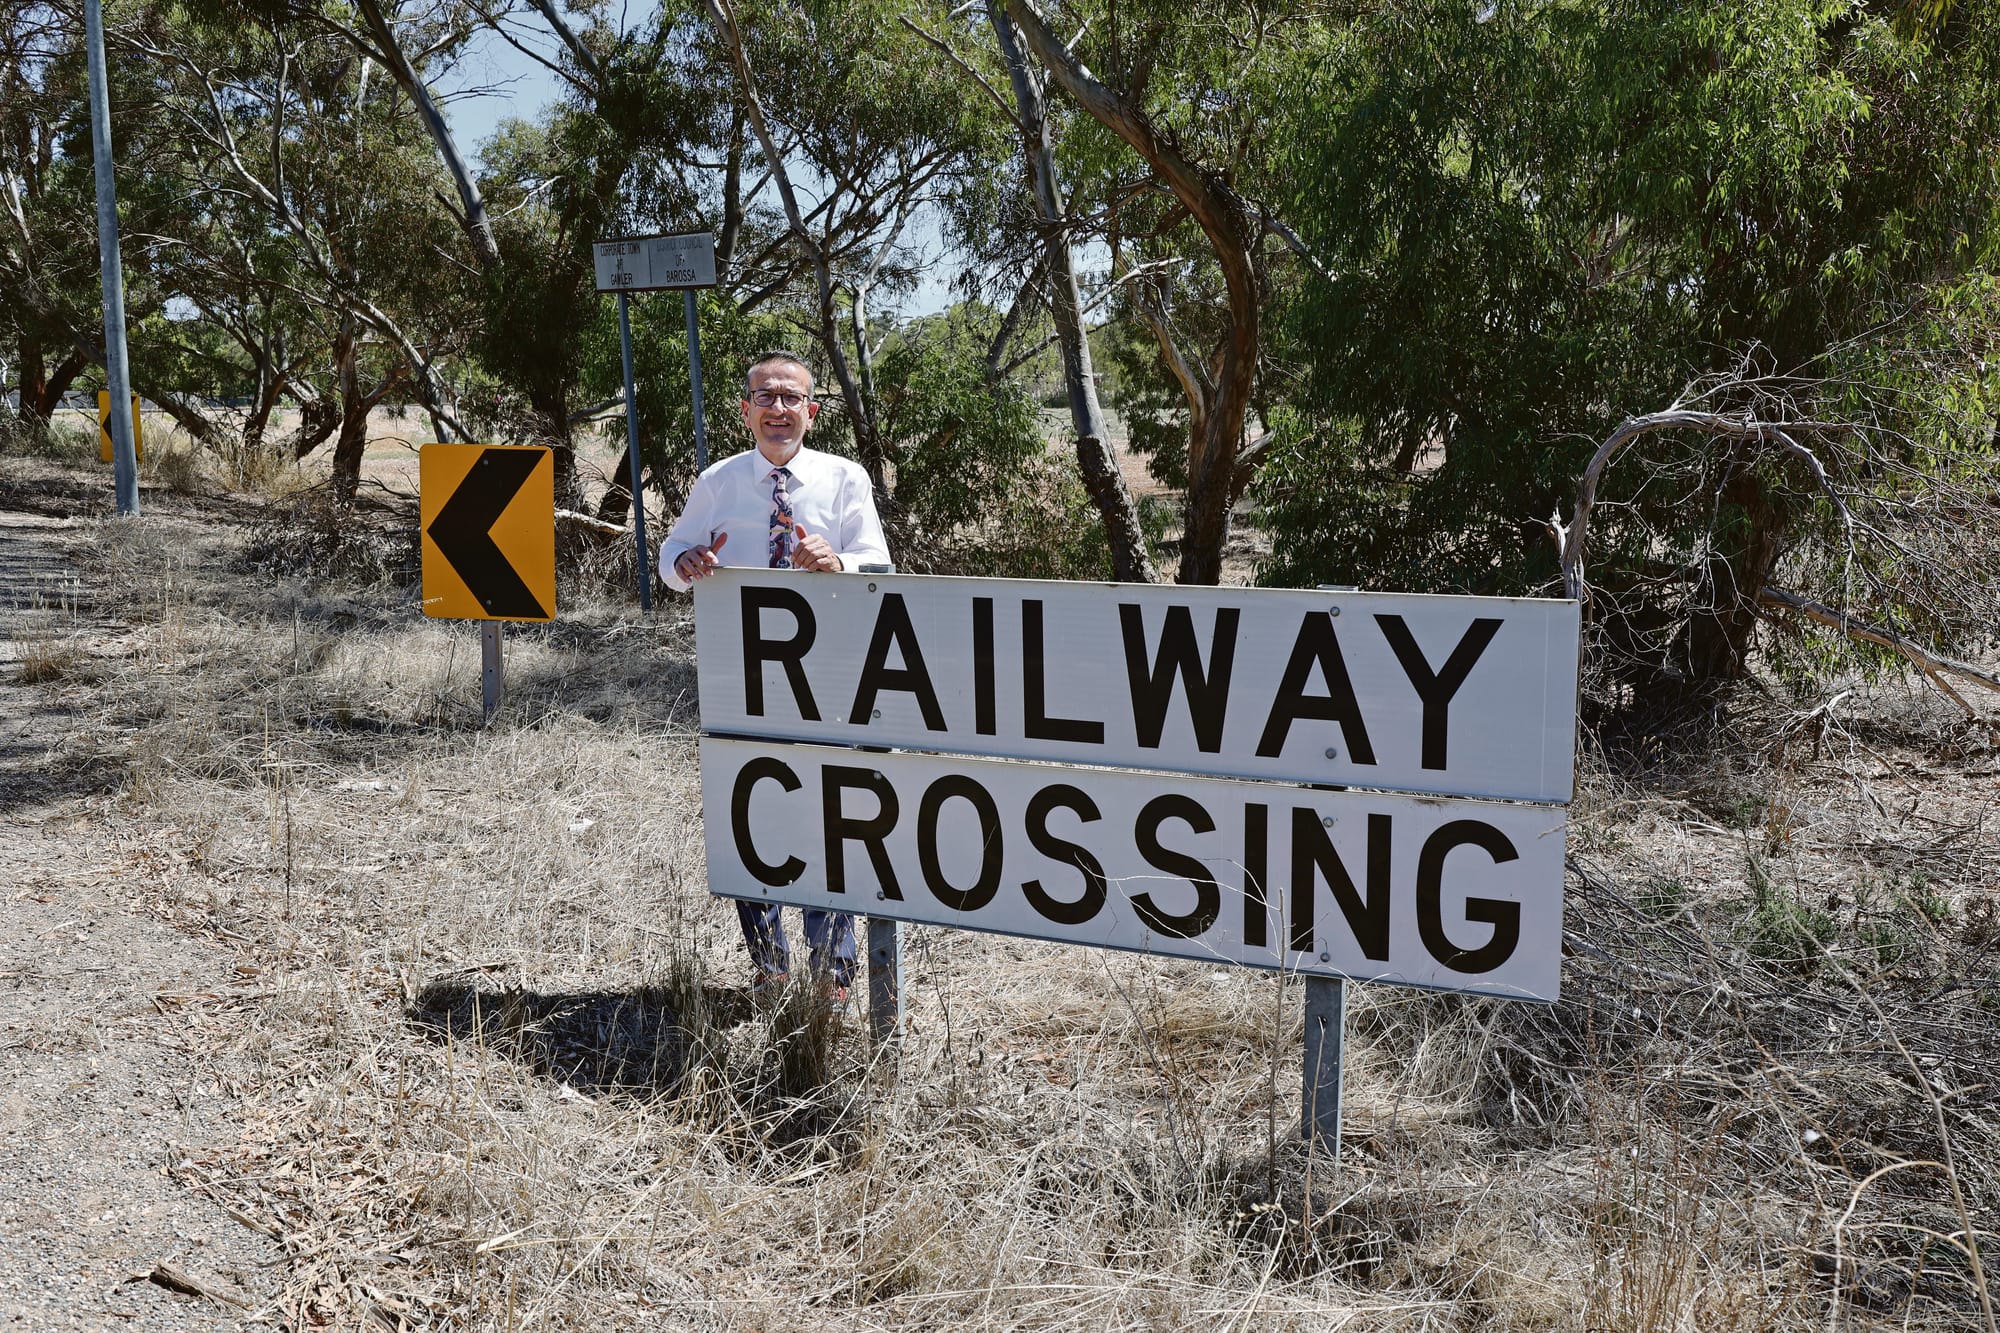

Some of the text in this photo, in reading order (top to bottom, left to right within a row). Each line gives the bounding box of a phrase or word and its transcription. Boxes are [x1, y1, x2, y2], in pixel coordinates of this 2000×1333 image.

[666, 269, 696, 282] BAROSSA
[740, 585, 1505, 771] RAILWAY
[730, 756, 1521, 975] CROSSING
